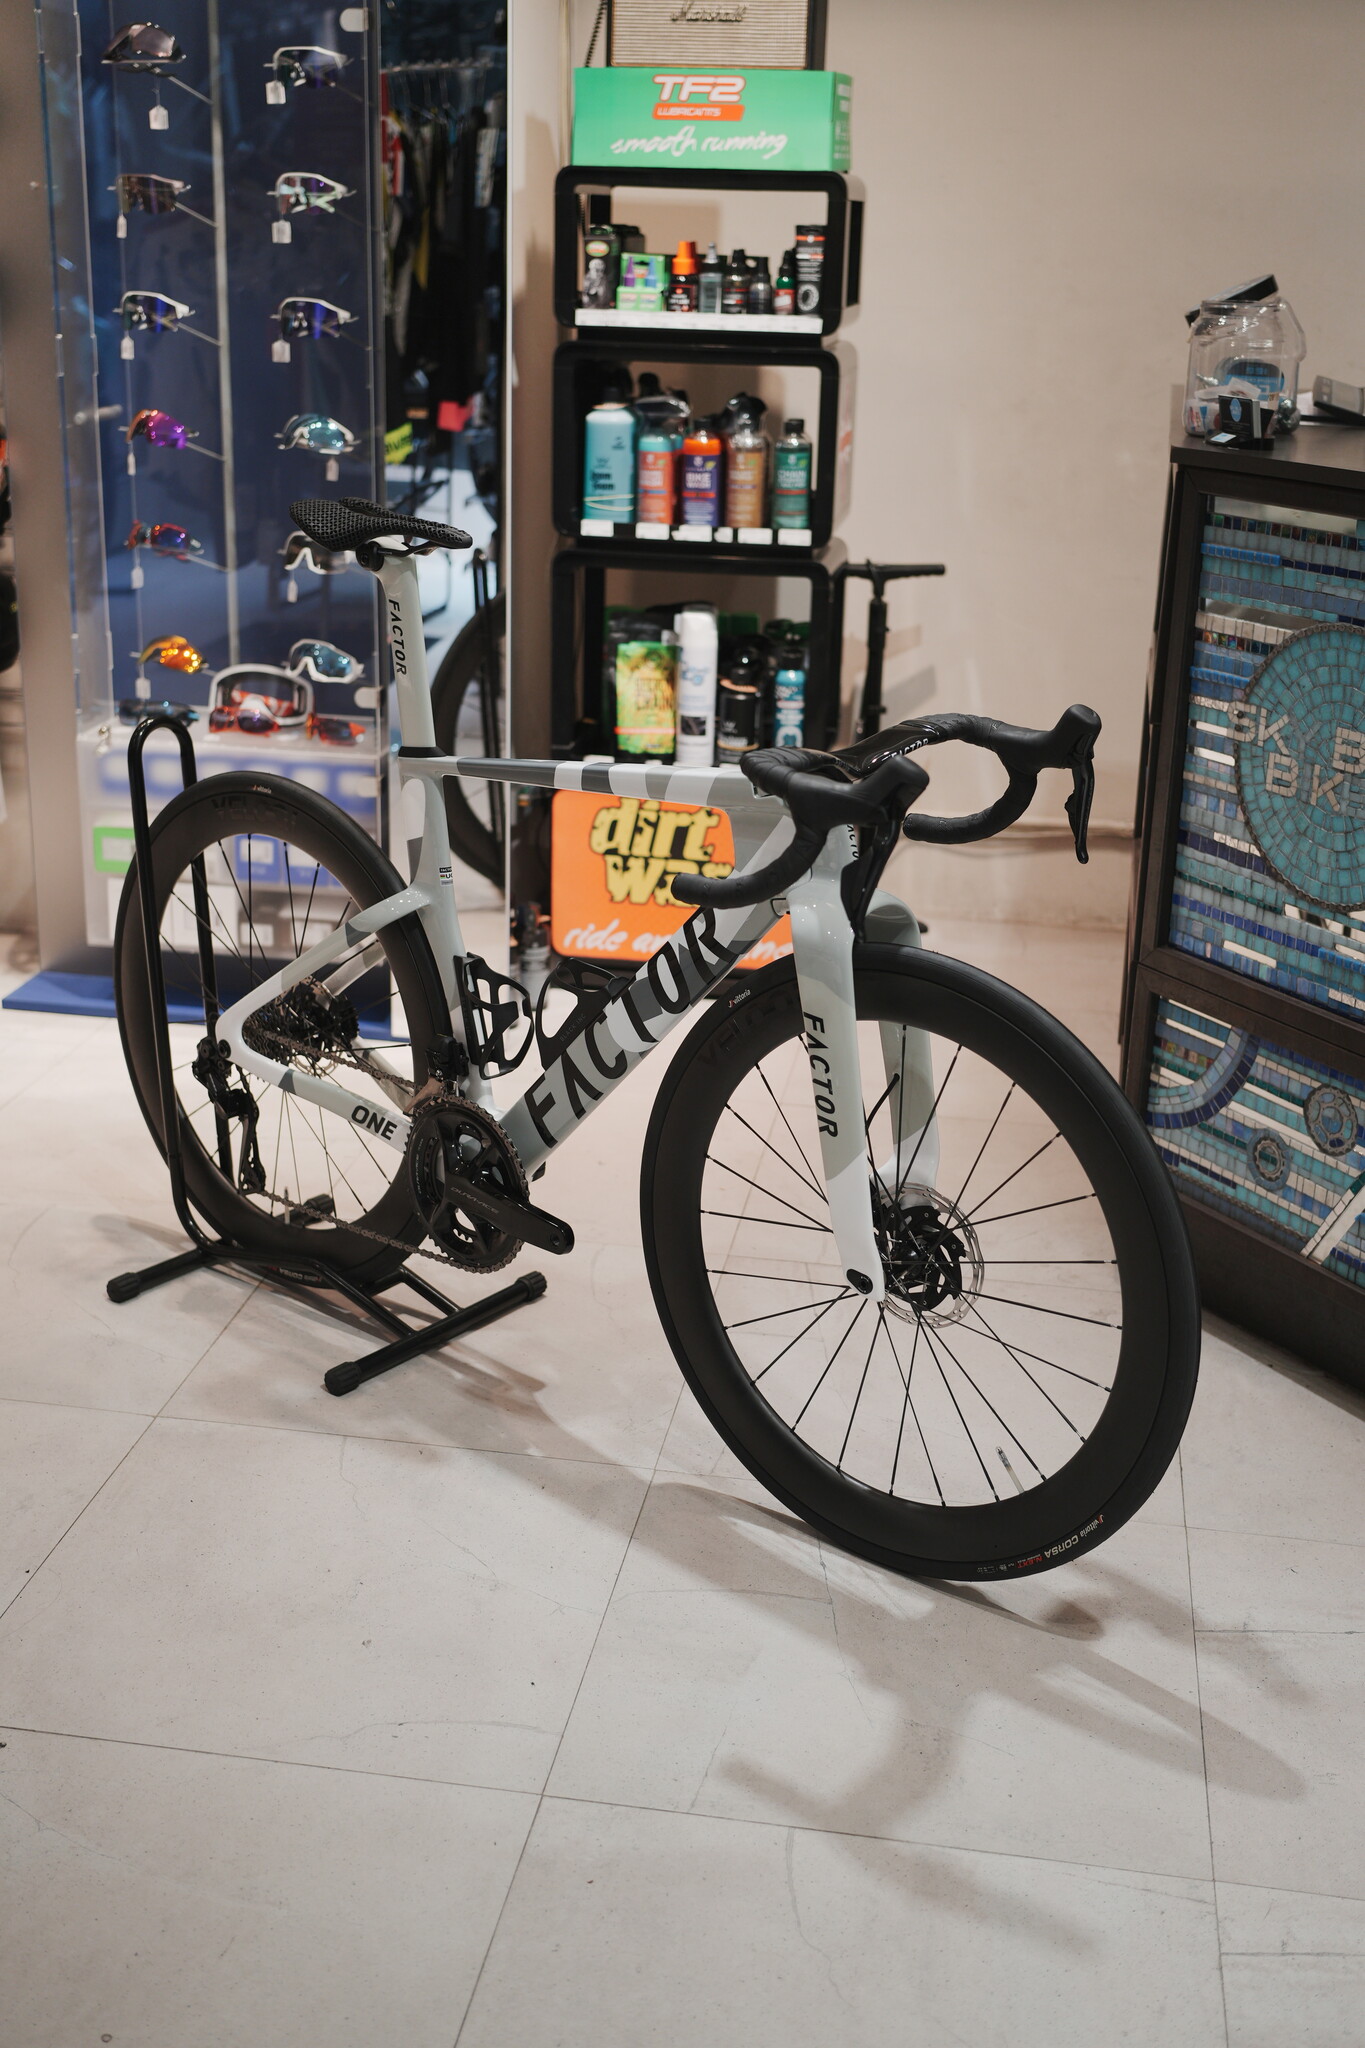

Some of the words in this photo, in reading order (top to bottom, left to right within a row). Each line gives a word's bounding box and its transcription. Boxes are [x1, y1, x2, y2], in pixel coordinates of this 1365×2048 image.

[652, 74, 746, 103] TF2
[610, 125, 697, 157] smooth
[700, 131, 788, 159] running
[388, 599, 407, 675] FACTOR
[590, 797, 720, 862] dirt
[846, 824, 860, 859] ACTO
[563, 918, 628, 951] ride
[631, 932, 672, 953] an
[524, 905, 747, 1148] FACTOR
[803, 1011, 839, 1138] FACTOR
[351, 1105, 398, 1141] ONE
[1044, 1534, 1079, 1558] CORSA
